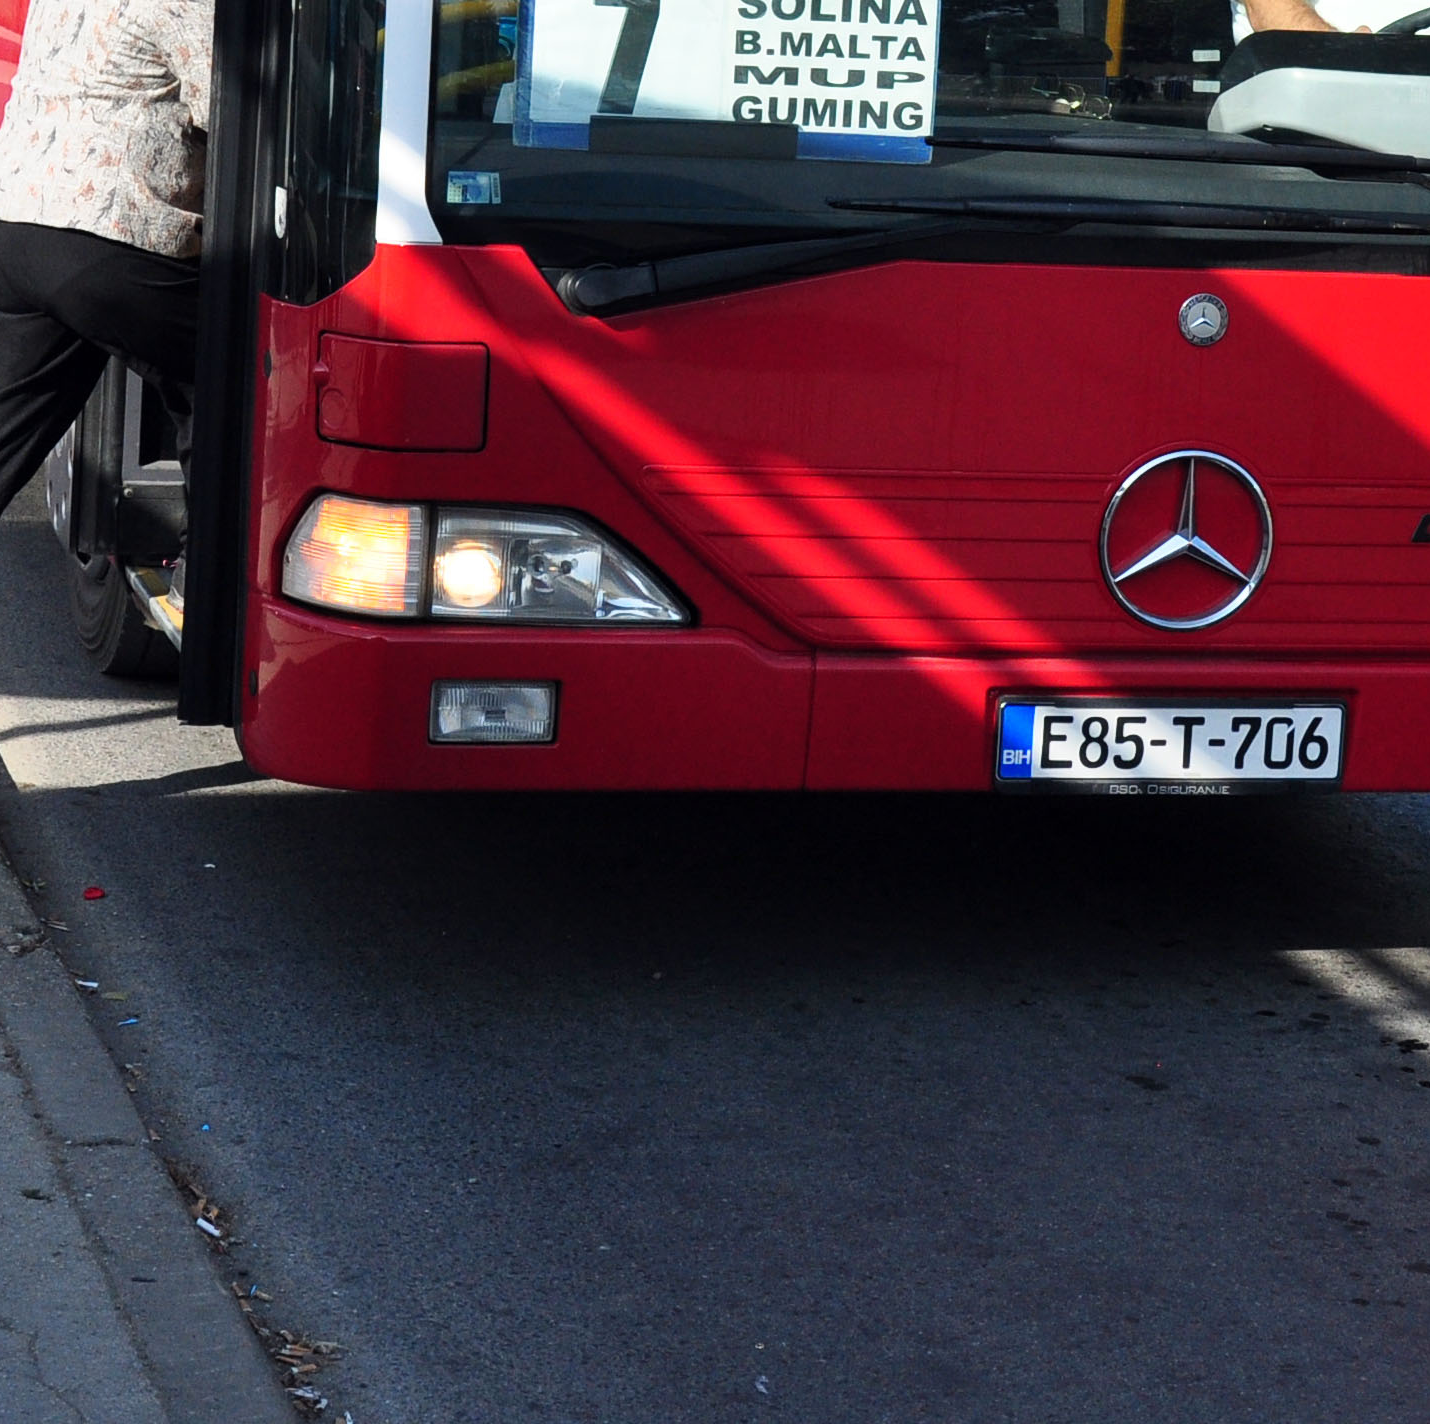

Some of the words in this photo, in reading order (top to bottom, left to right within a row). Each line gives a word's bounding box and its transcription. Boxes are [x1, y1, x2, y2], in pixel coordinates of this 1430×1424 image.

[735, 30, 926, 61] B.MALTA
[733, 66, 926, 89] MUP
[732, 96, 924, 131] GUMING
[1002, 749, 1032, 765] BIH
[1041, 715, 1329, 770] E85-T-706
